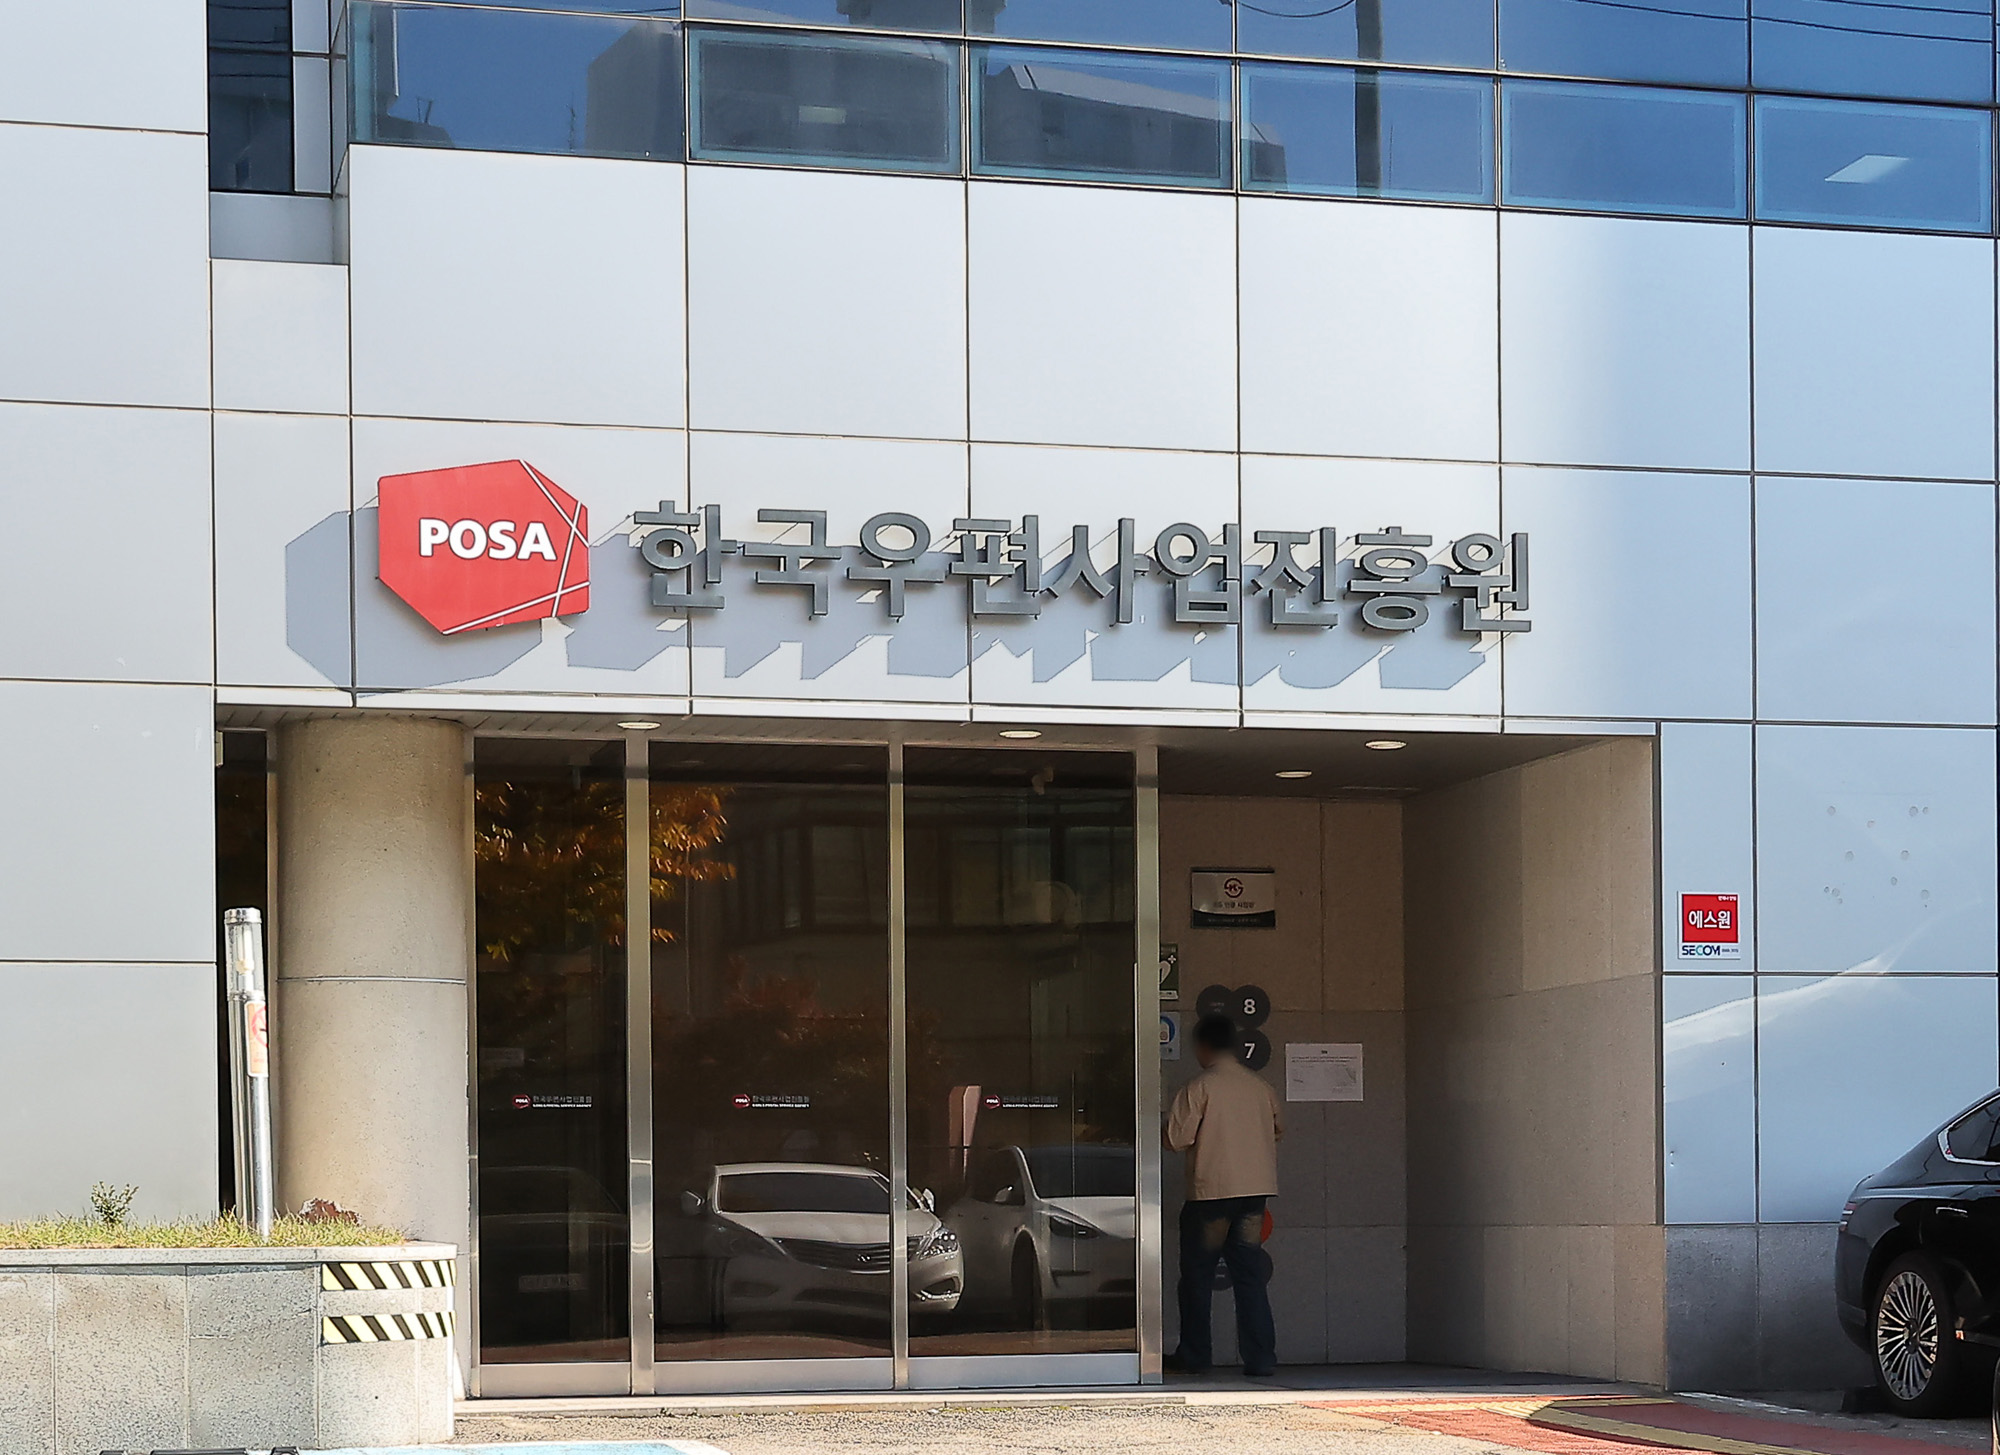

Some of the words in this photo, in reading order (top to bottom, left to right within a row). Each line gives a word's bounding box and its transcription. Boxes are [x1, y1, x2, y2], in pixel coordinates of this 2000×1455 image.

[419, 518, 557, 562] POSA
[633, 500, 1532, 633] 한국우편사업진흥원
[1688, 910, 1731, 929] 에스원
[1682, 945, 1720, 956] SECOM
[1243, 998, 1256, 1015] 8
[1244, 1043, 1256, 1059] 7
